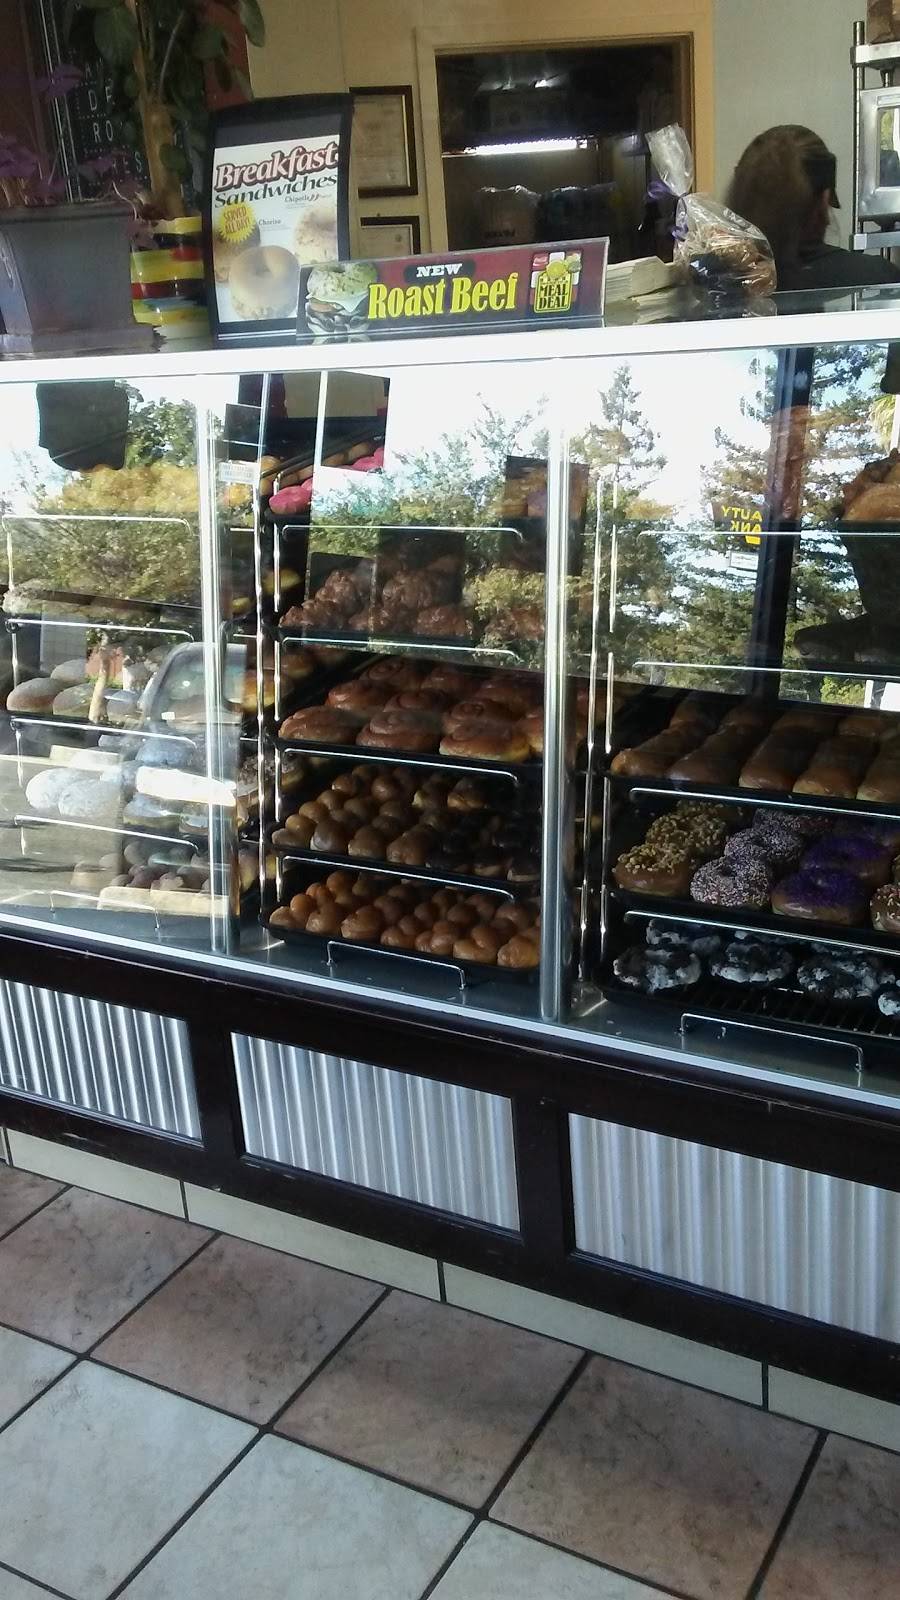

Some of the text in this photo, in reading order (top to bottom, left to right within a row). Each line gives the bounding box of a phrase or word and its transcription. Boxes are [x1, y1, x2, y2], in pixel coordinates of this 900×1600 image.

[214, 141, 338, 192] Breakfast
[214, 174, 337, 208] Sandwiches
[223, 206, 248, 220] SERVED
[416, 263, 463, 278] NEW
[367, 271, 520, 320] Roast Beef
[539, 283, 569, 298] MEAL
[538, 295, 569, 309] DEAL
